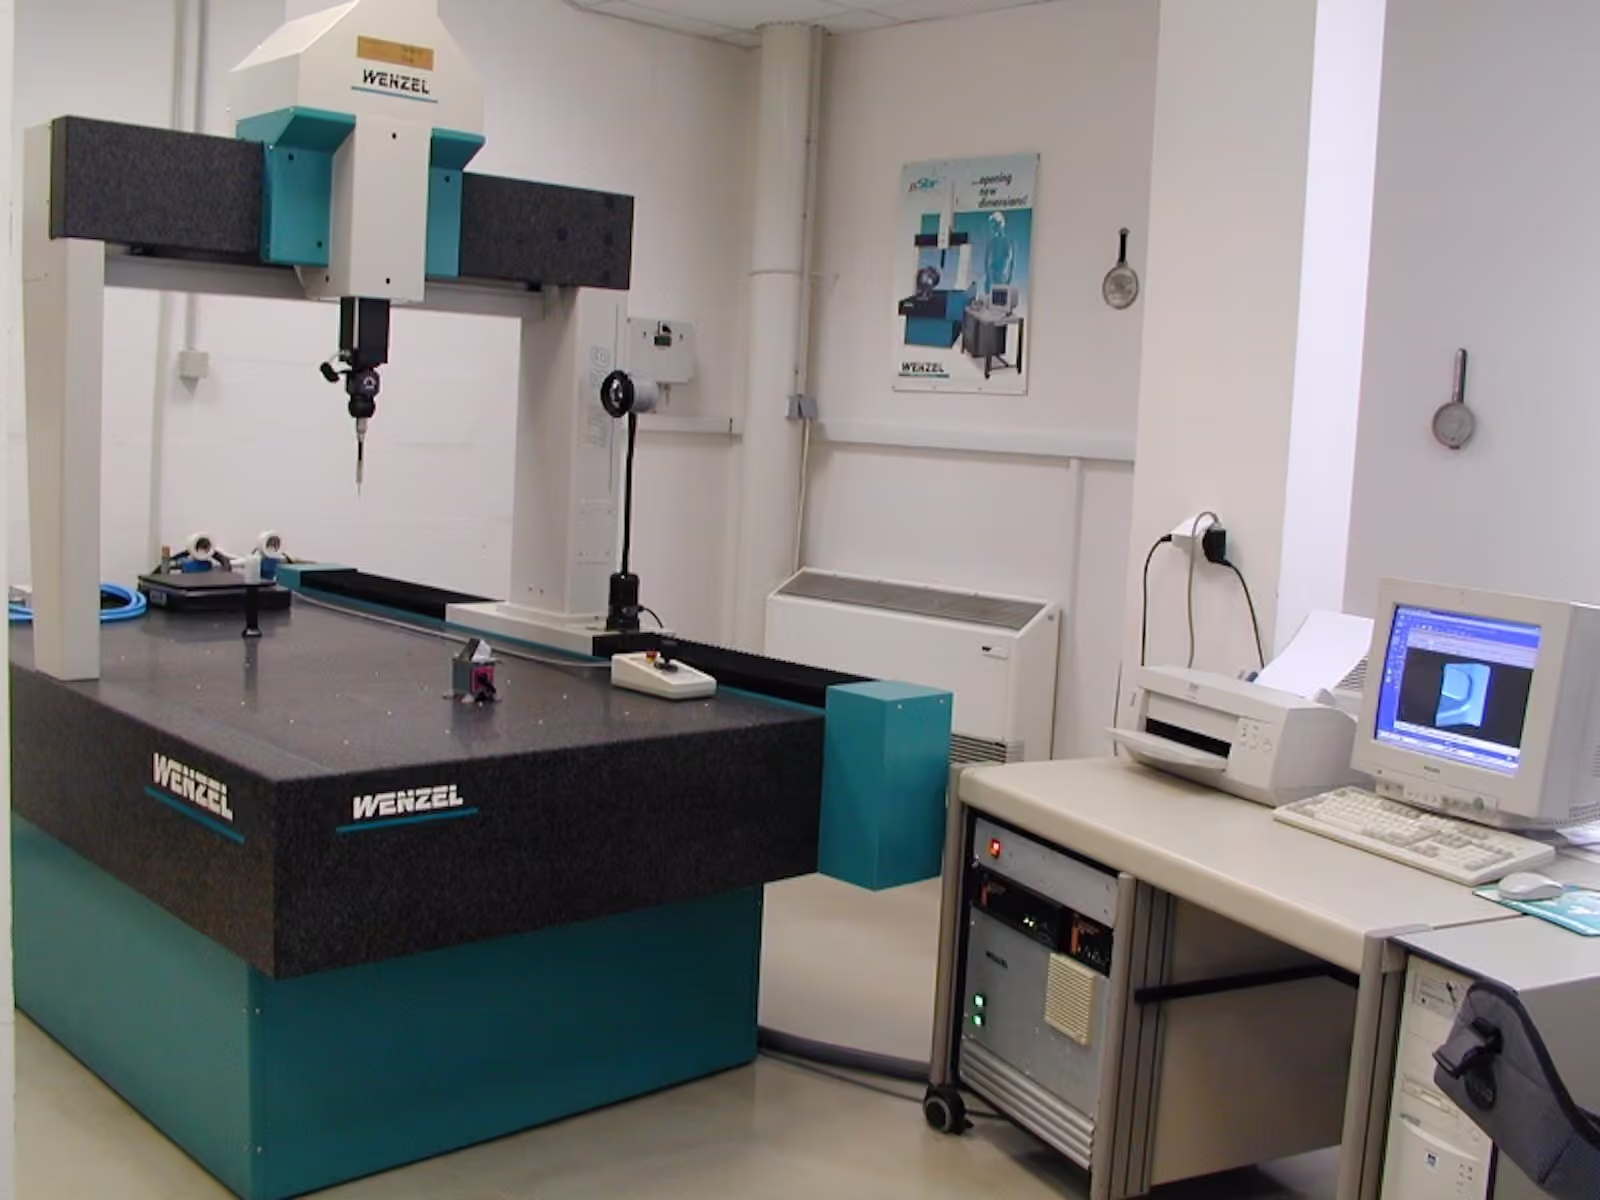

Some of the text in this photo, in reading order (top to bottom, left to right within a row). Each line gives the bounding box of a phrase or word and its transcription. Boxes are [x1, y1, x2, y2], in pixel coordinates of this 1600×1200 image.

[363, 69, 430, 94] WENZEL
[901, 362, 944, 373] WENZEL
[152, 752, 233, 821] WENZEL
[352, 784, 463, 819] WENZEL
